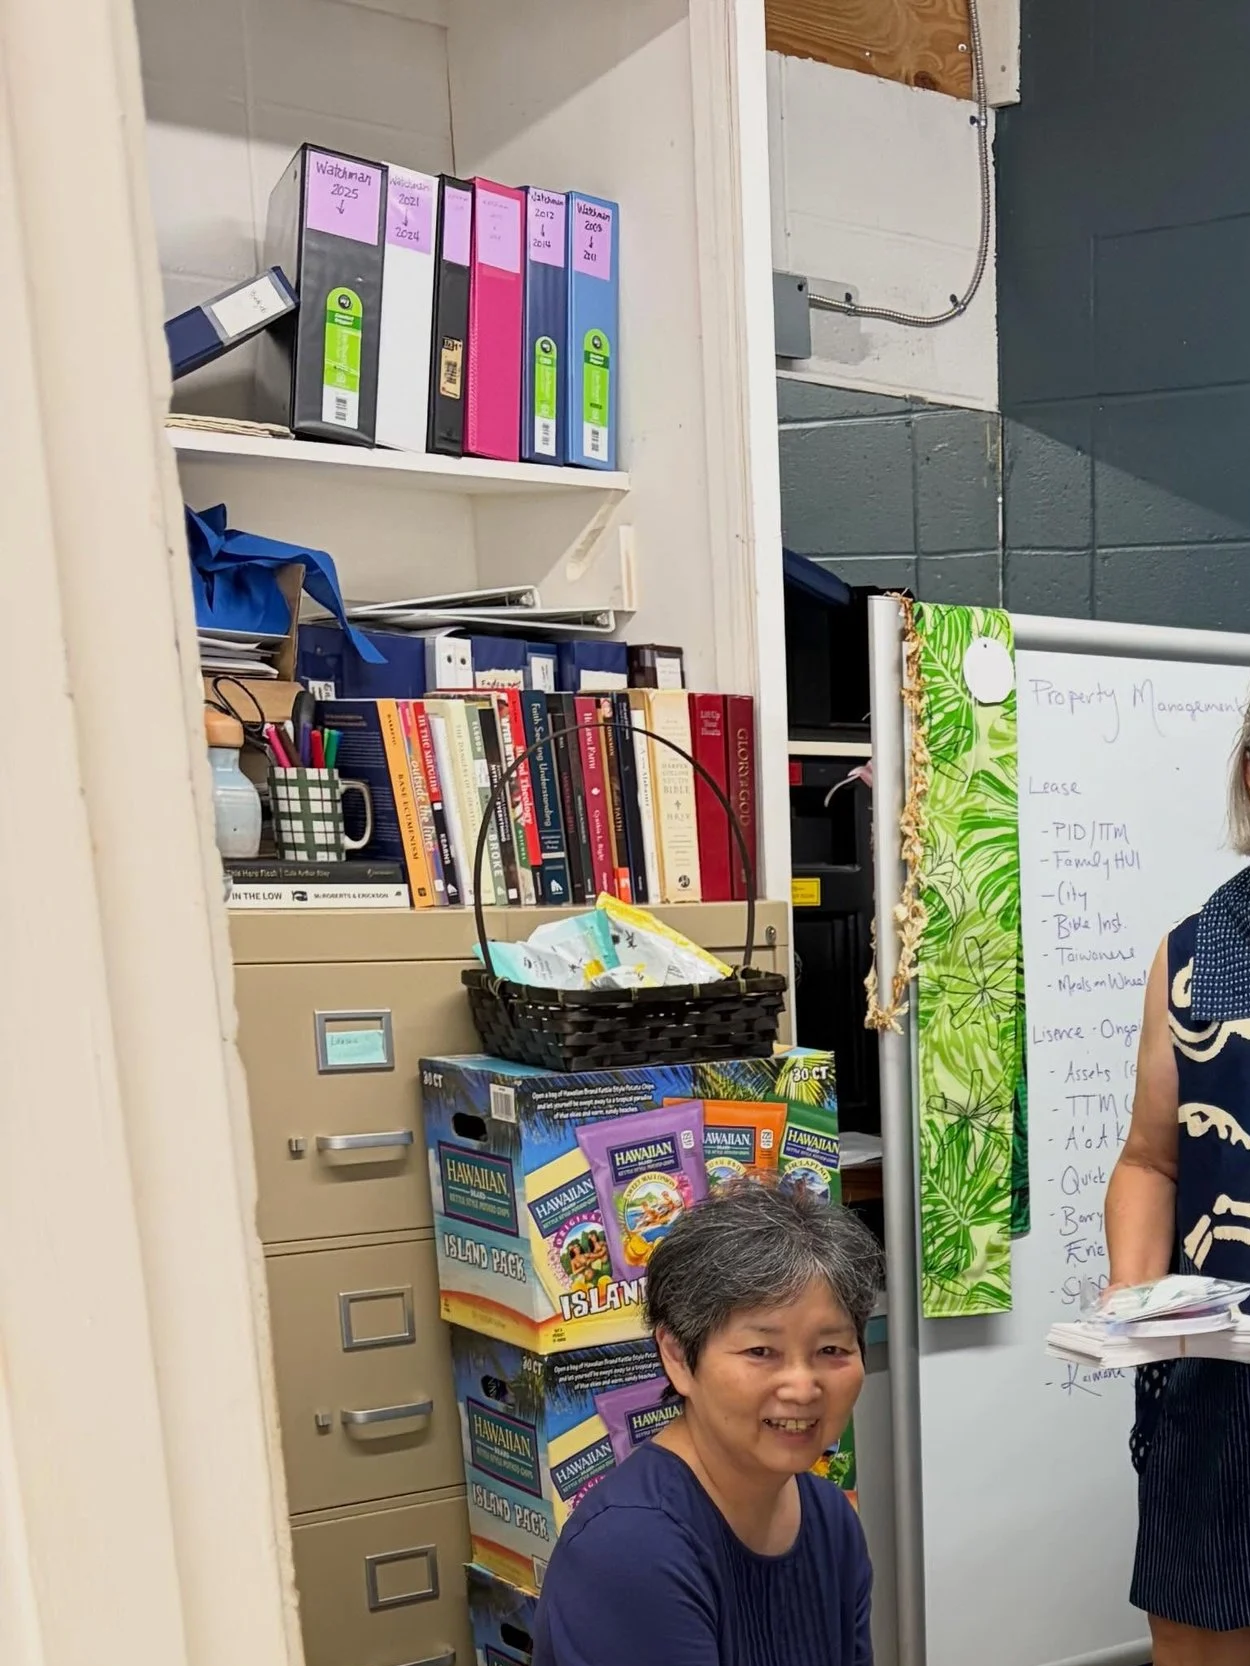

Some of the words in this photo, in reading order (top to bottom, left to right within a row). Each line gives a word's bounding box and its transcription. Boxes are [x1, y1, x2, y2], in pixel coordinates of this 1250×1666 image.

[316, 161, 372, 186] Watchman
[331, 184, 359, 200] 2025
[398, 194, 419, 207] 2021
[535, 209, 555, 220] 2012
[395, 227, 419, 242] 2024
[532, 238, 552, 248] 2014
[1028, 679, 1121, 744] Property
[1133, 678, 1249, 738] Management
[531, 703, 542, 725] Faith
[539, 763, 553, 827] Understanding
[737, 728, 748, 780] GLORY
[411, 760, 427, 803] outside
[664, 785, 689, 794] BIBLE
[1028, 776, 1082, 796] Lease
[418, 805, 432, 823] the
[520, 778, 534, 825] Theology
[739, 789, 750, 828] GOD
[397, 773, 405, 798] BASE
[402, 802, 419, 860] ECUMENISM
[420, 825, 436, 853] lines
[440, 833, 451, 865] KEARNS
[488, 834, 503, 877] BROKE
[1053, 850, 1111, 881] Family
[1114, 850, 1141, 870] HUI
[231, 893, 241, 901] IN
[242, 893, 261, 901] THE
[262, 892, 282, 901] LOW
[1057, 880, 1088, 912] City
[1053, 913, 1091, 940] Bible
[1055, 947, 1135, 966] Taiwanese
[1058, 974, 1093, 997] Meals
[1032, 1022, 1085, 1045] Lisence
[433, 1072, 443, 1089] CT
[792, 1067, 809, 1083] 30
[811, 1066, 829, 1080] CT
[1064, 1060, 1111, 1084] Assets
[1065, 1093, 1119, 1119] TTM
[704, 1131, 750, 1146] AWAIIAN
[788, 1129, 839, 1155] HAWAIIAN
[614, 1141, 673, 1167] HAWAIIAN
[446, 1158, 507, 1196] HAWAIIAN
[1061, 1165, 1107, 1196] Quick
[535, 1178, 595, 1219] HAWAIIAN
[443, 1233, 488, 1269] ISLAND
[491, 1247, 526, 1282] PACK
[523, 1355, 532, 1371] 30
[533, 1360, 543, 1376] CT
[632, 1405, 683, 1429] HAWAIIA
[473, 1414, 532, 1458] HAWAIIAN
[555, 1442, 612, 1483] HAWAIIAN
[472, 1482, 511, 1524] ISLAND
[514, 1503, 549, 1541] PACK
